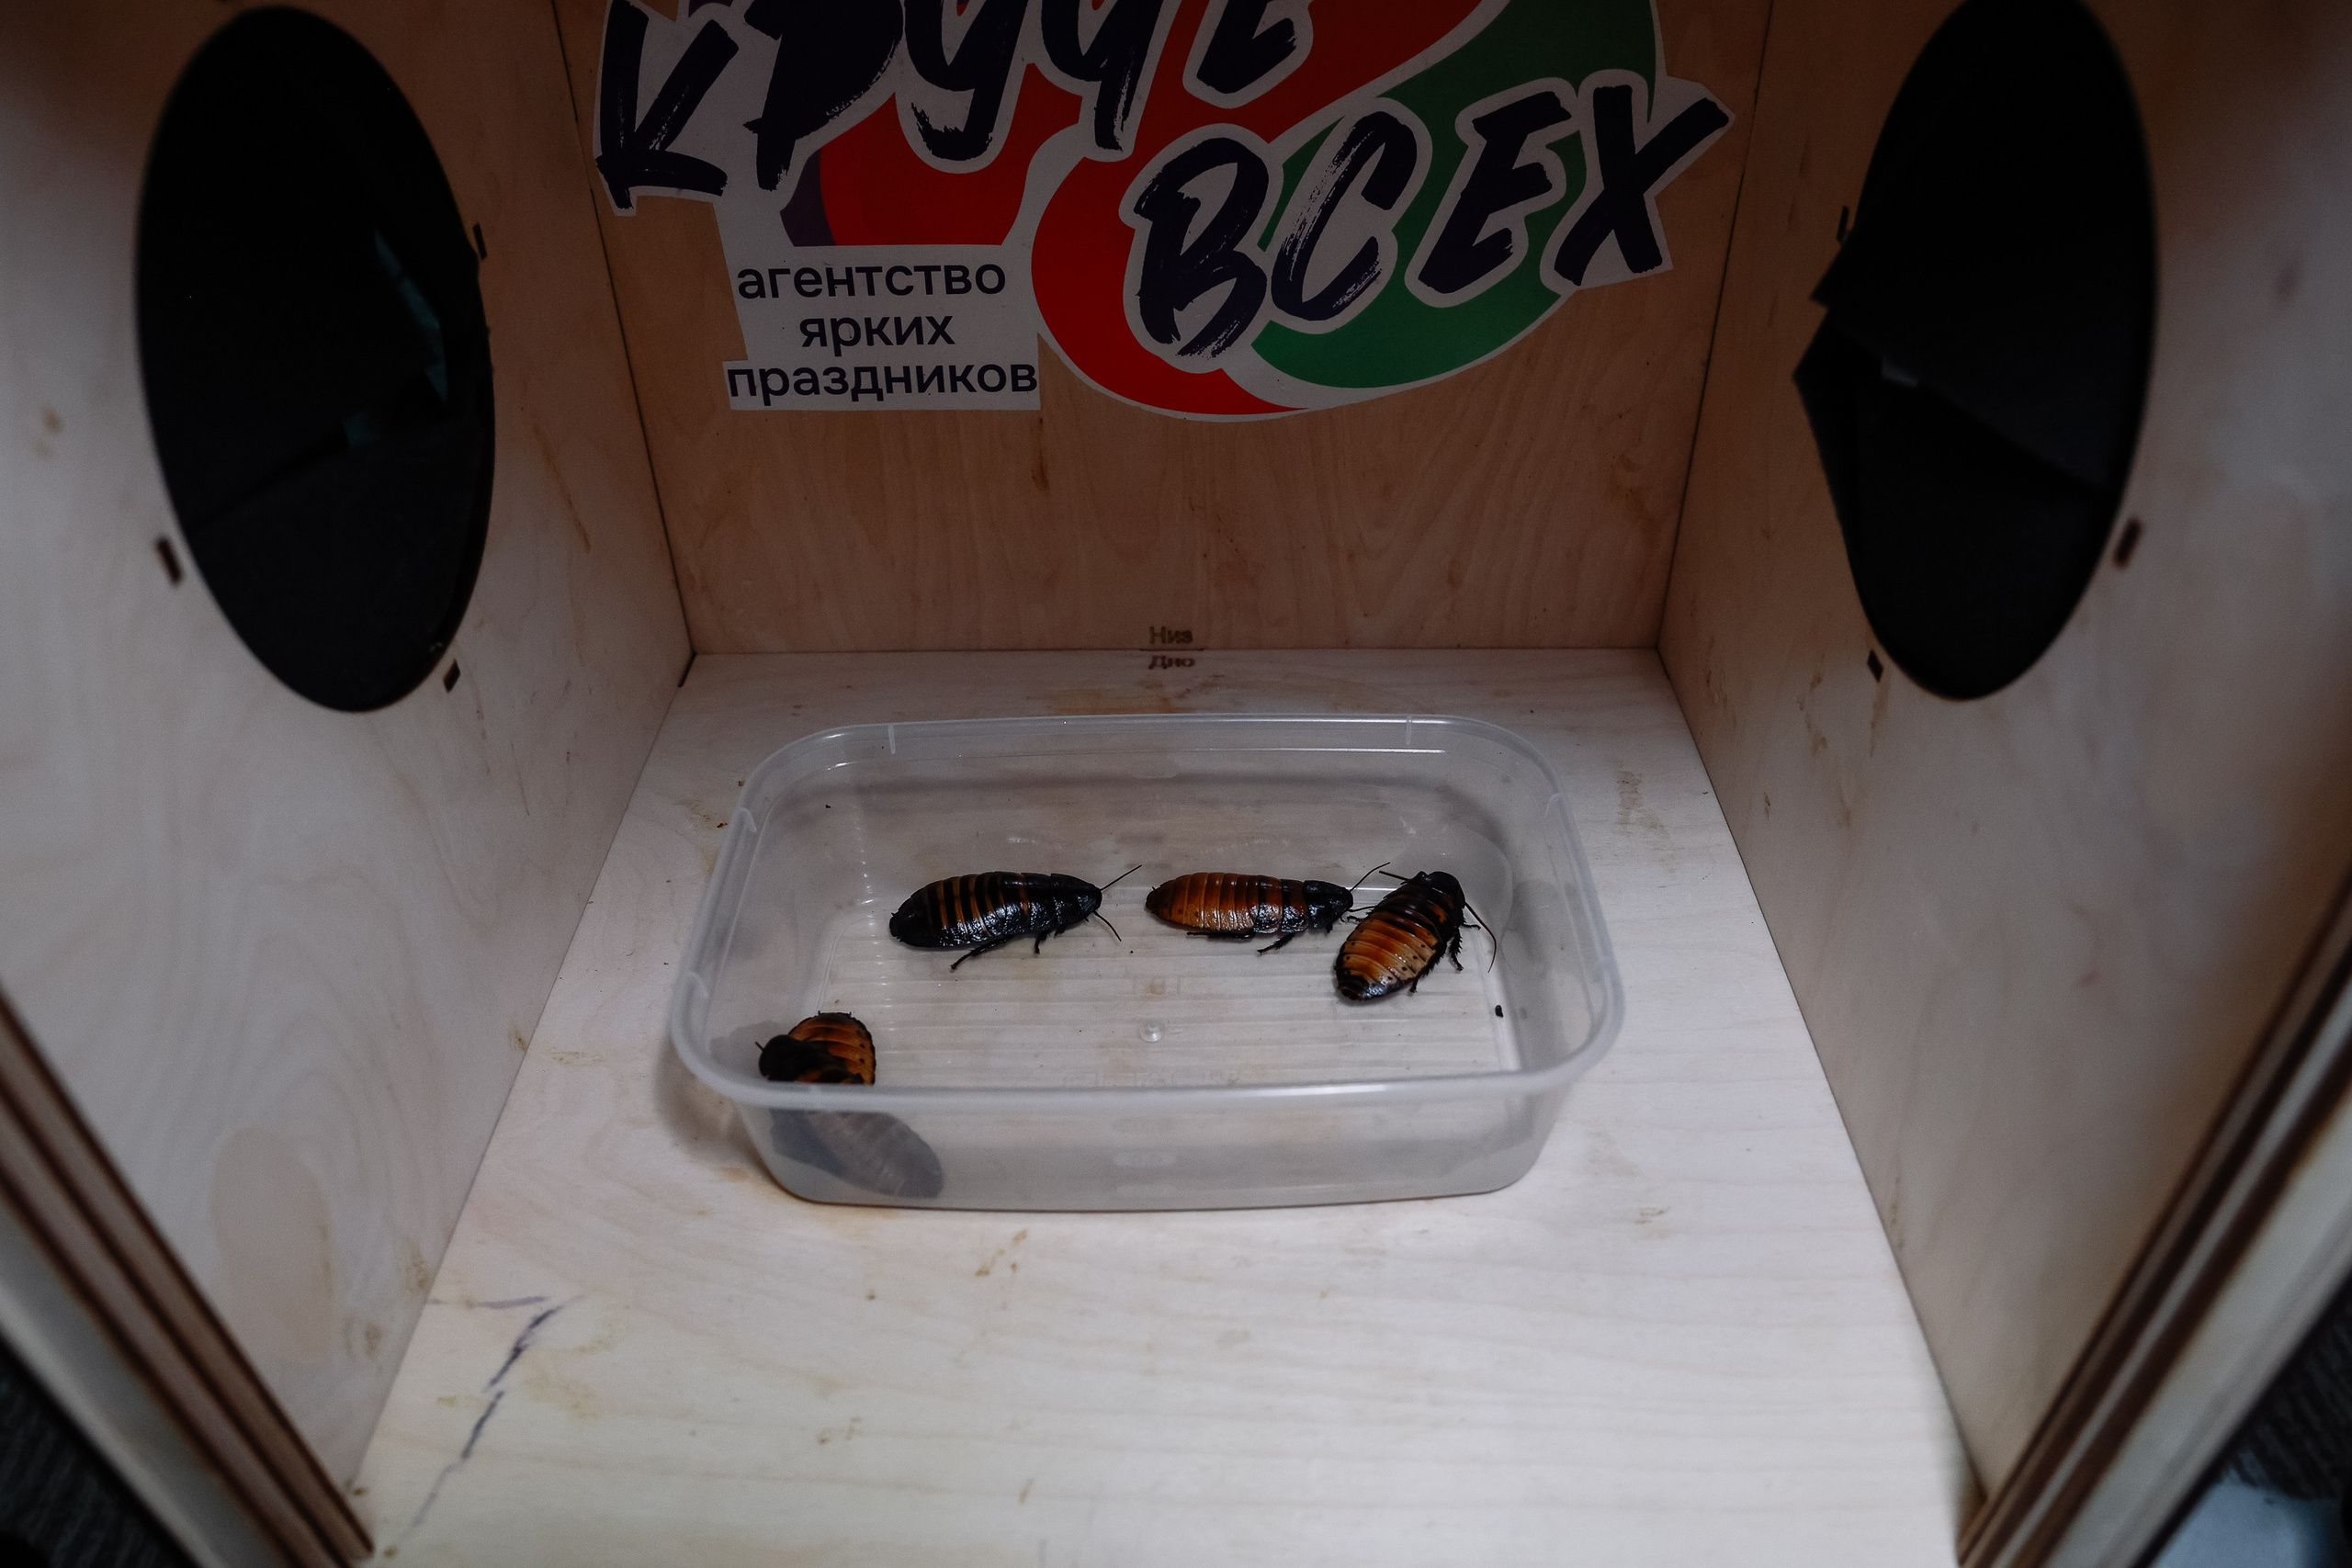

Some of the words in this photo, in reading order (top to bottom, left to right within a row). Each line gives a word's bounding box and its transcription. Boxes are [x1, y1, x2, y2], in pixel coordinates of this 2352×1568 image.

[1133, 85, 1730, 358] ВСЕХ
[737, 263, 1006, 299] агентство
[800, 315, 956, 357] ярких
[727, 363, 1038, 406] праздников
